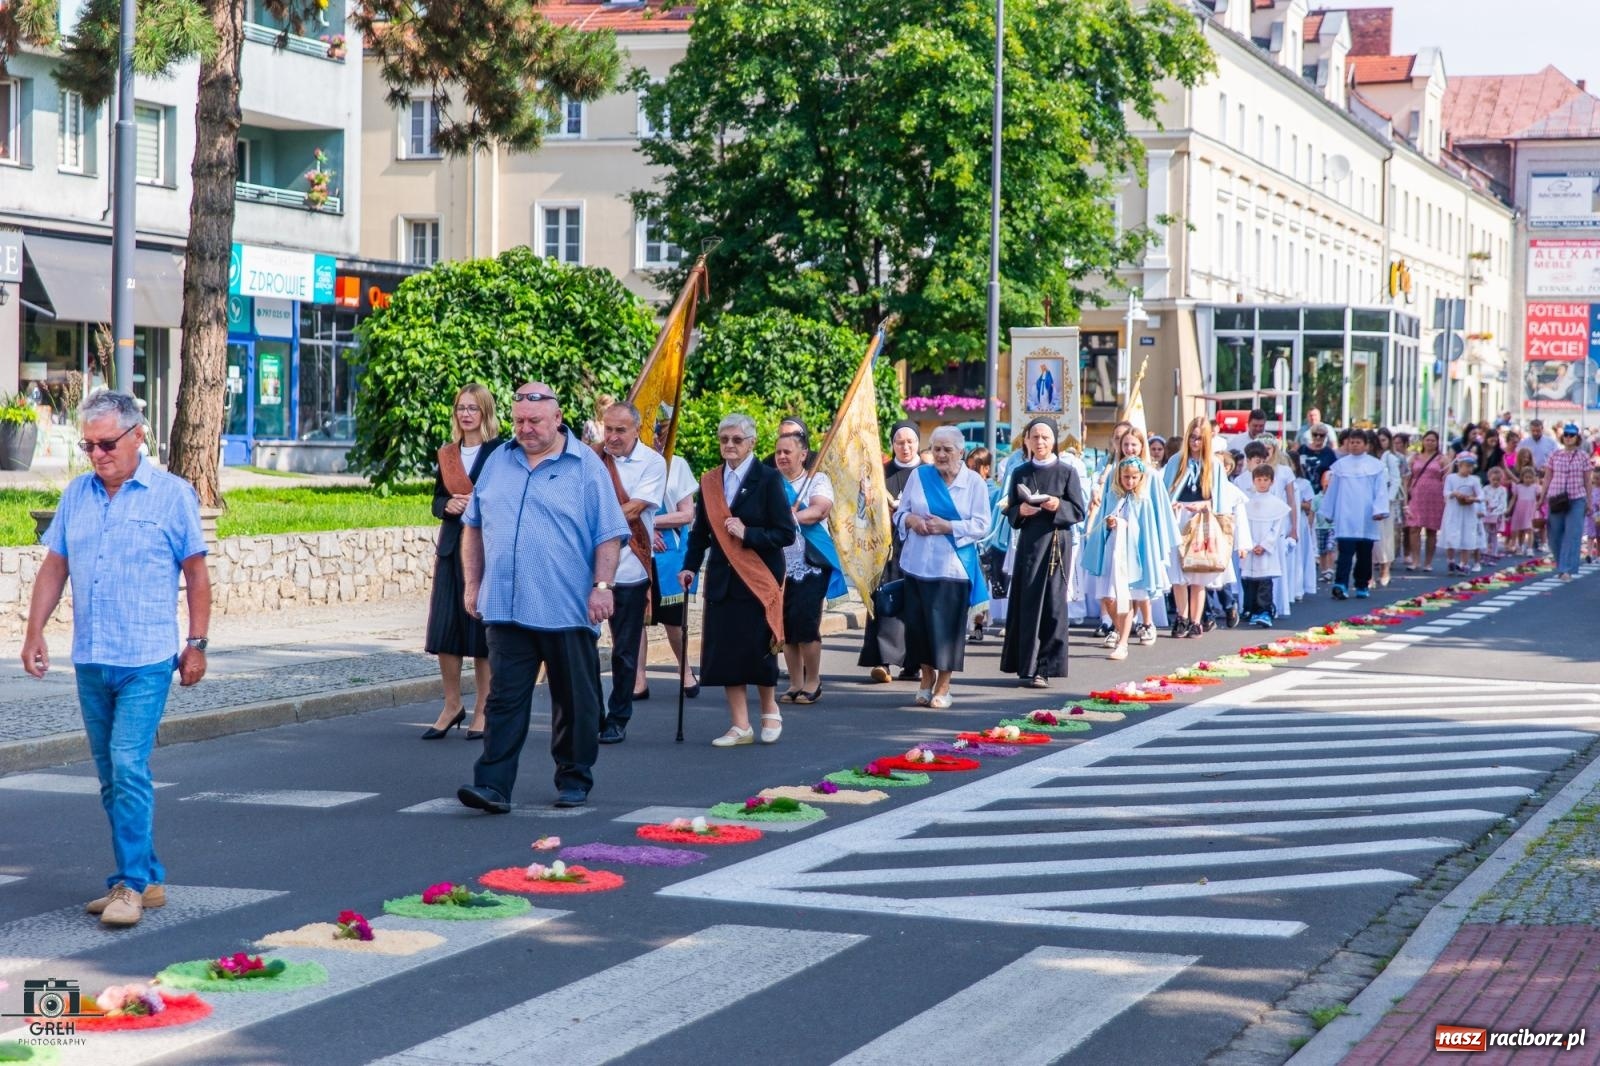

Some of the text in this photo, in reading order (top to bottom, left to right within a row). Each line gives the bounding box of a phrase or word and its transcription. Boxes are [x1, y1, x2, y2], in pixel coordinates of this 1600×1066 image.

[249, 270, 306, 297] ZDROWIE
[1528, 303, 1588, 318] FOTELIKI
[1528, 321, 1588, 340] RATUJĄ
[1528, 337, 1584, 356] ŻYCIE!
